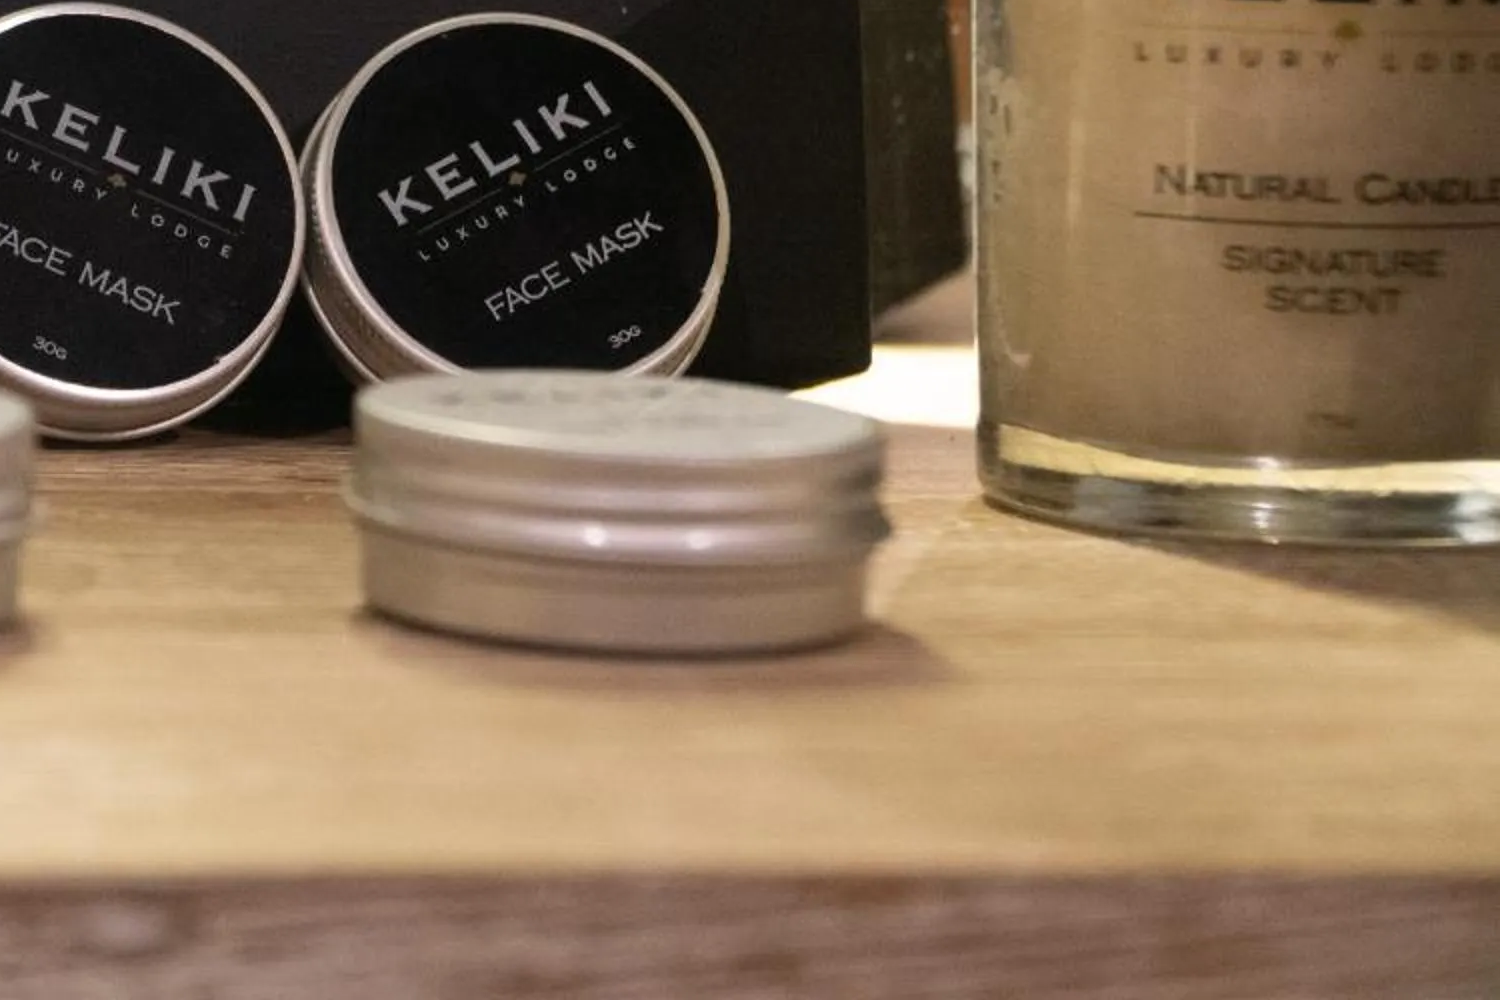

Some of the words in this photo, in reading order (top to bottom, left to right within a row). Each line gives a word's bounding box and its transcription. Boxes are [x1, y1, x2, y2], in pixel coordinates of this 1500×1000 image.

[0, 79, 257, 222] KELIKI
[377, 80, 613, 227] KELIKI
[131, 203, 234, 259] LODGE
[418, 194, 526, 262] LUXURY
[545, 137, 637, 193] LODGE
[78, 261, 181, 325] MASK
[484, 260, 572, 322] FACE
[570, 210, 665, 275] MASK
[1220, 244, 1446, 280] SIGNATURE
[1264, 286, 1408, 316] SCENT
